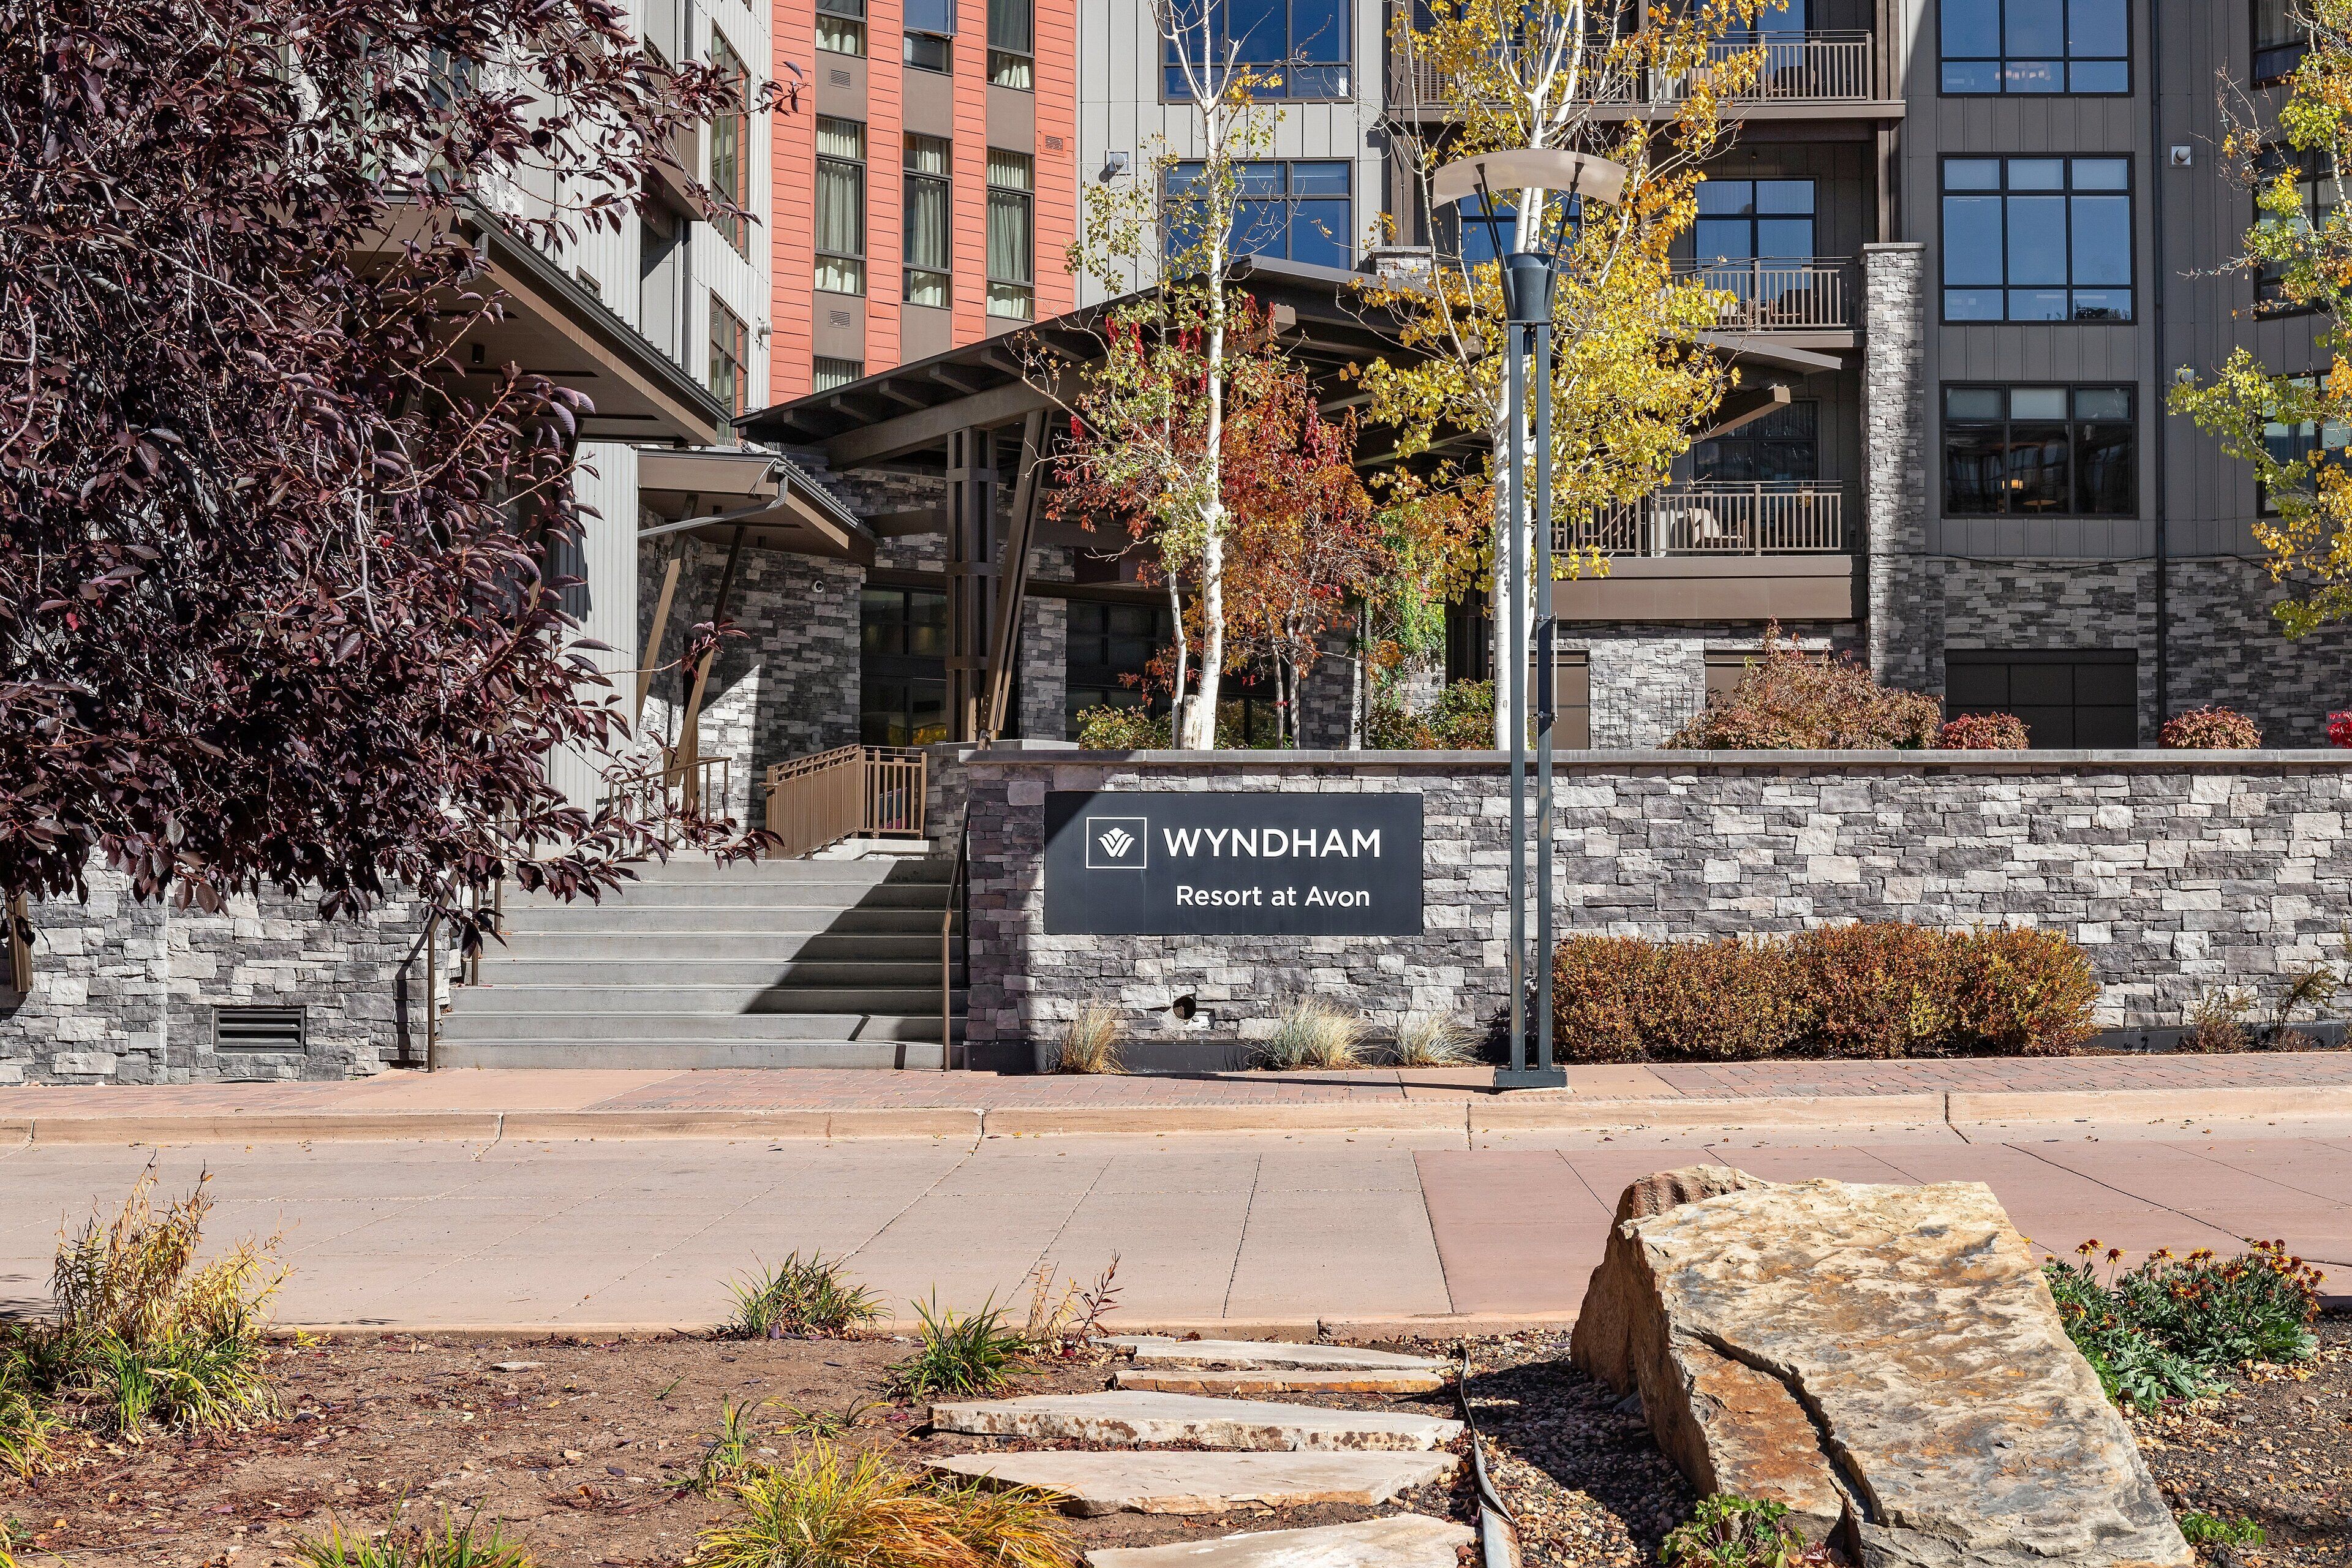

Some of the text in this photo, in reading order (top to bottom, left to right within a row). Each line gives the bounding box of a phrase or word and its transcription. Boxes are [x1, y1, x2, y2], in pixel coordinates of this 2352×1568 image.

[1163, 827, 1381, 858] WYNDHAM
[1176, 885, 1370, 907] Resort at Avon
